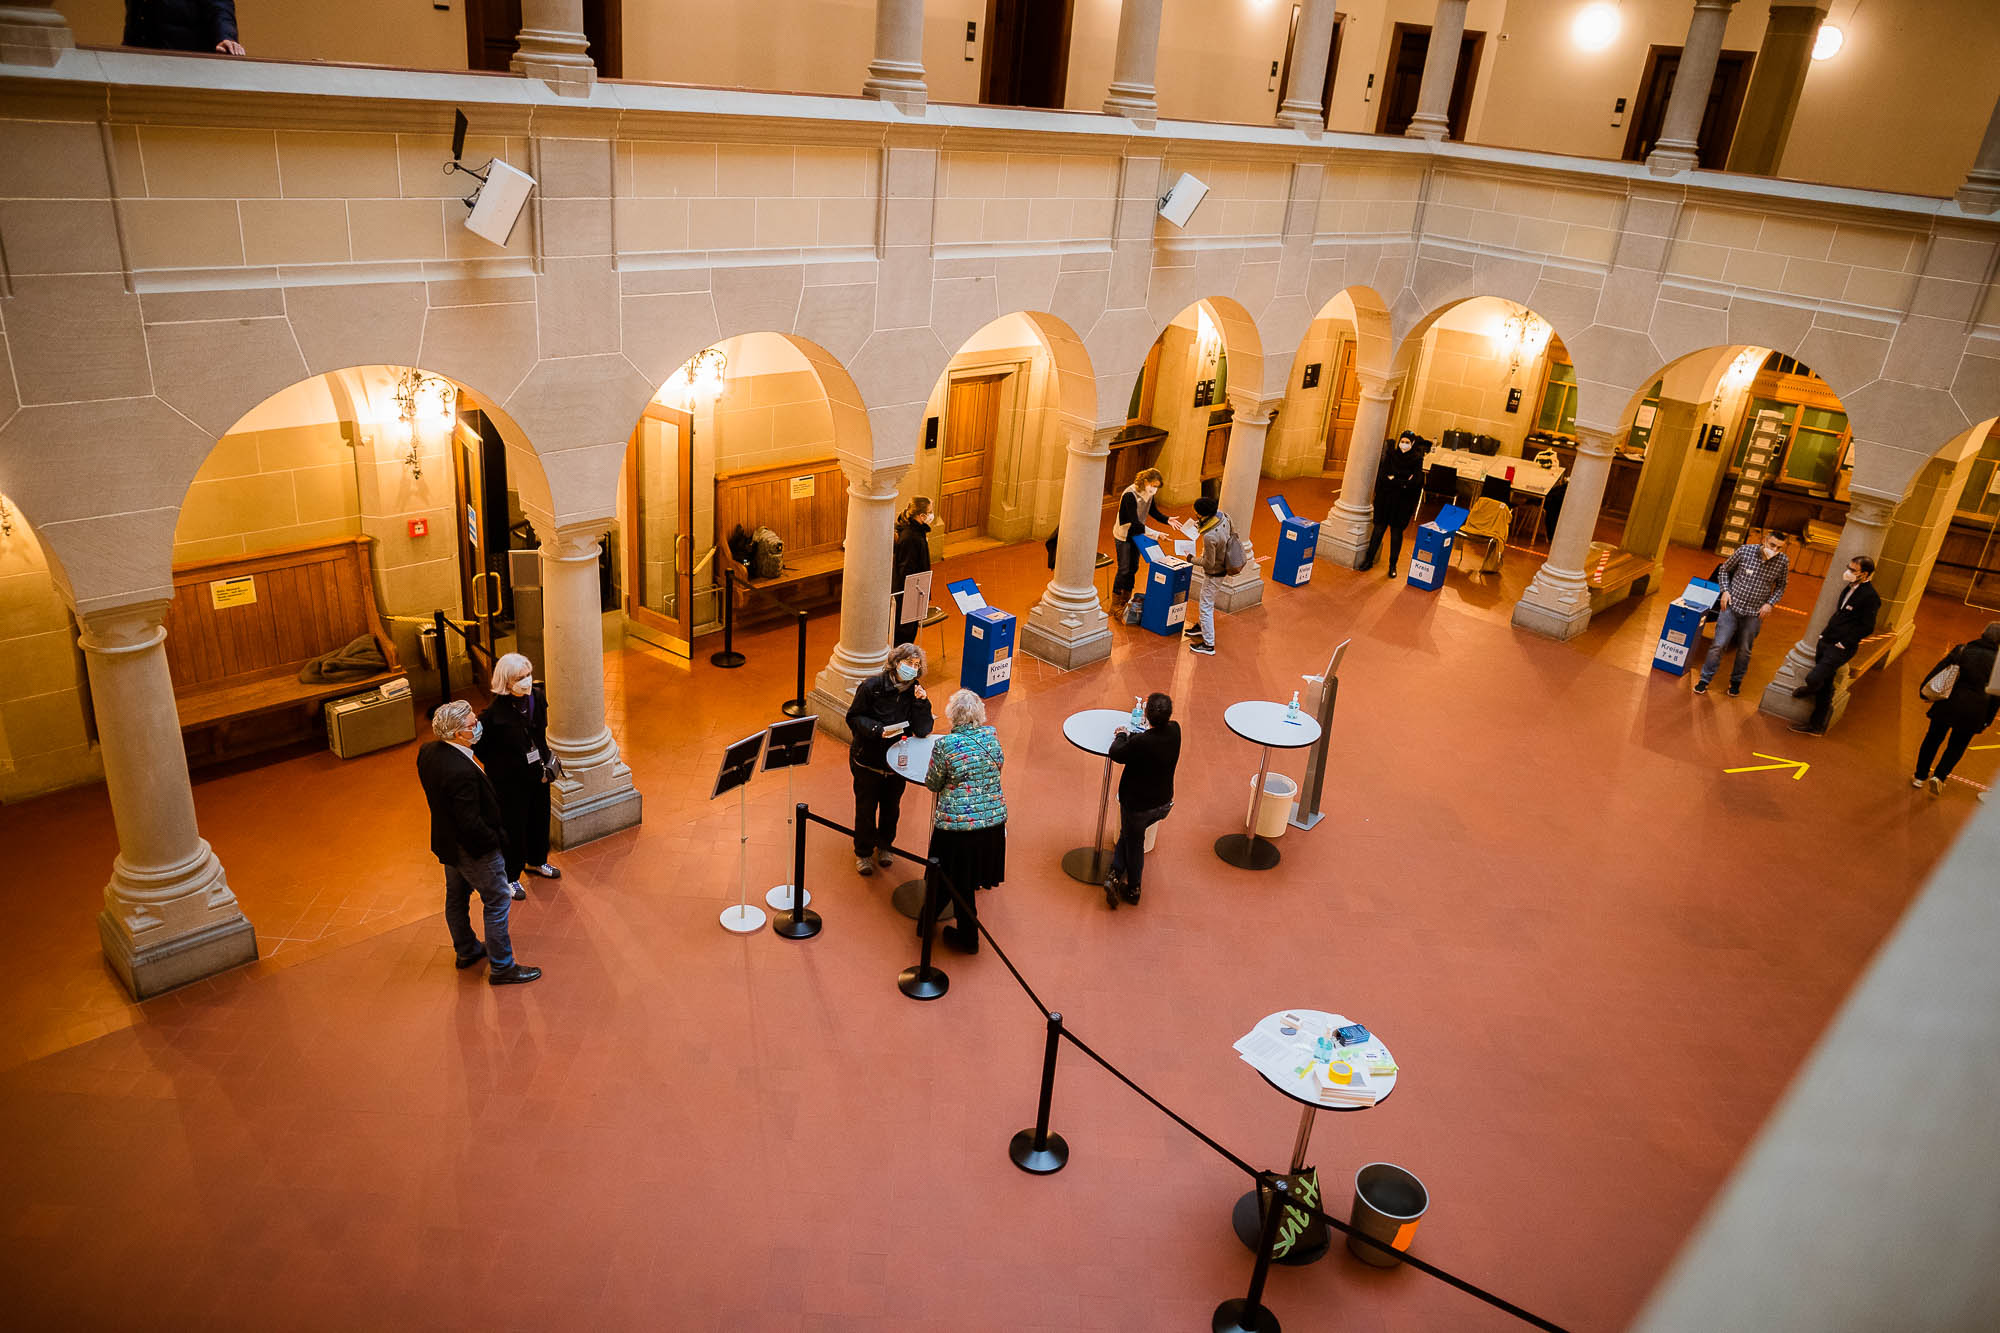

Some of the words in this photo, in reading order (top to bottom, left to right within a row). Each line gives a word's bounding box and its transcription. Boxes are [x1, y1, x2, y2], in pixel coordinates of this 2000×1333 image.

[1415, 562, 1430, 572] Kreis
[1660, 642, 1684, 654] Kreise
[990, 662, 1008, 672] Kreise
